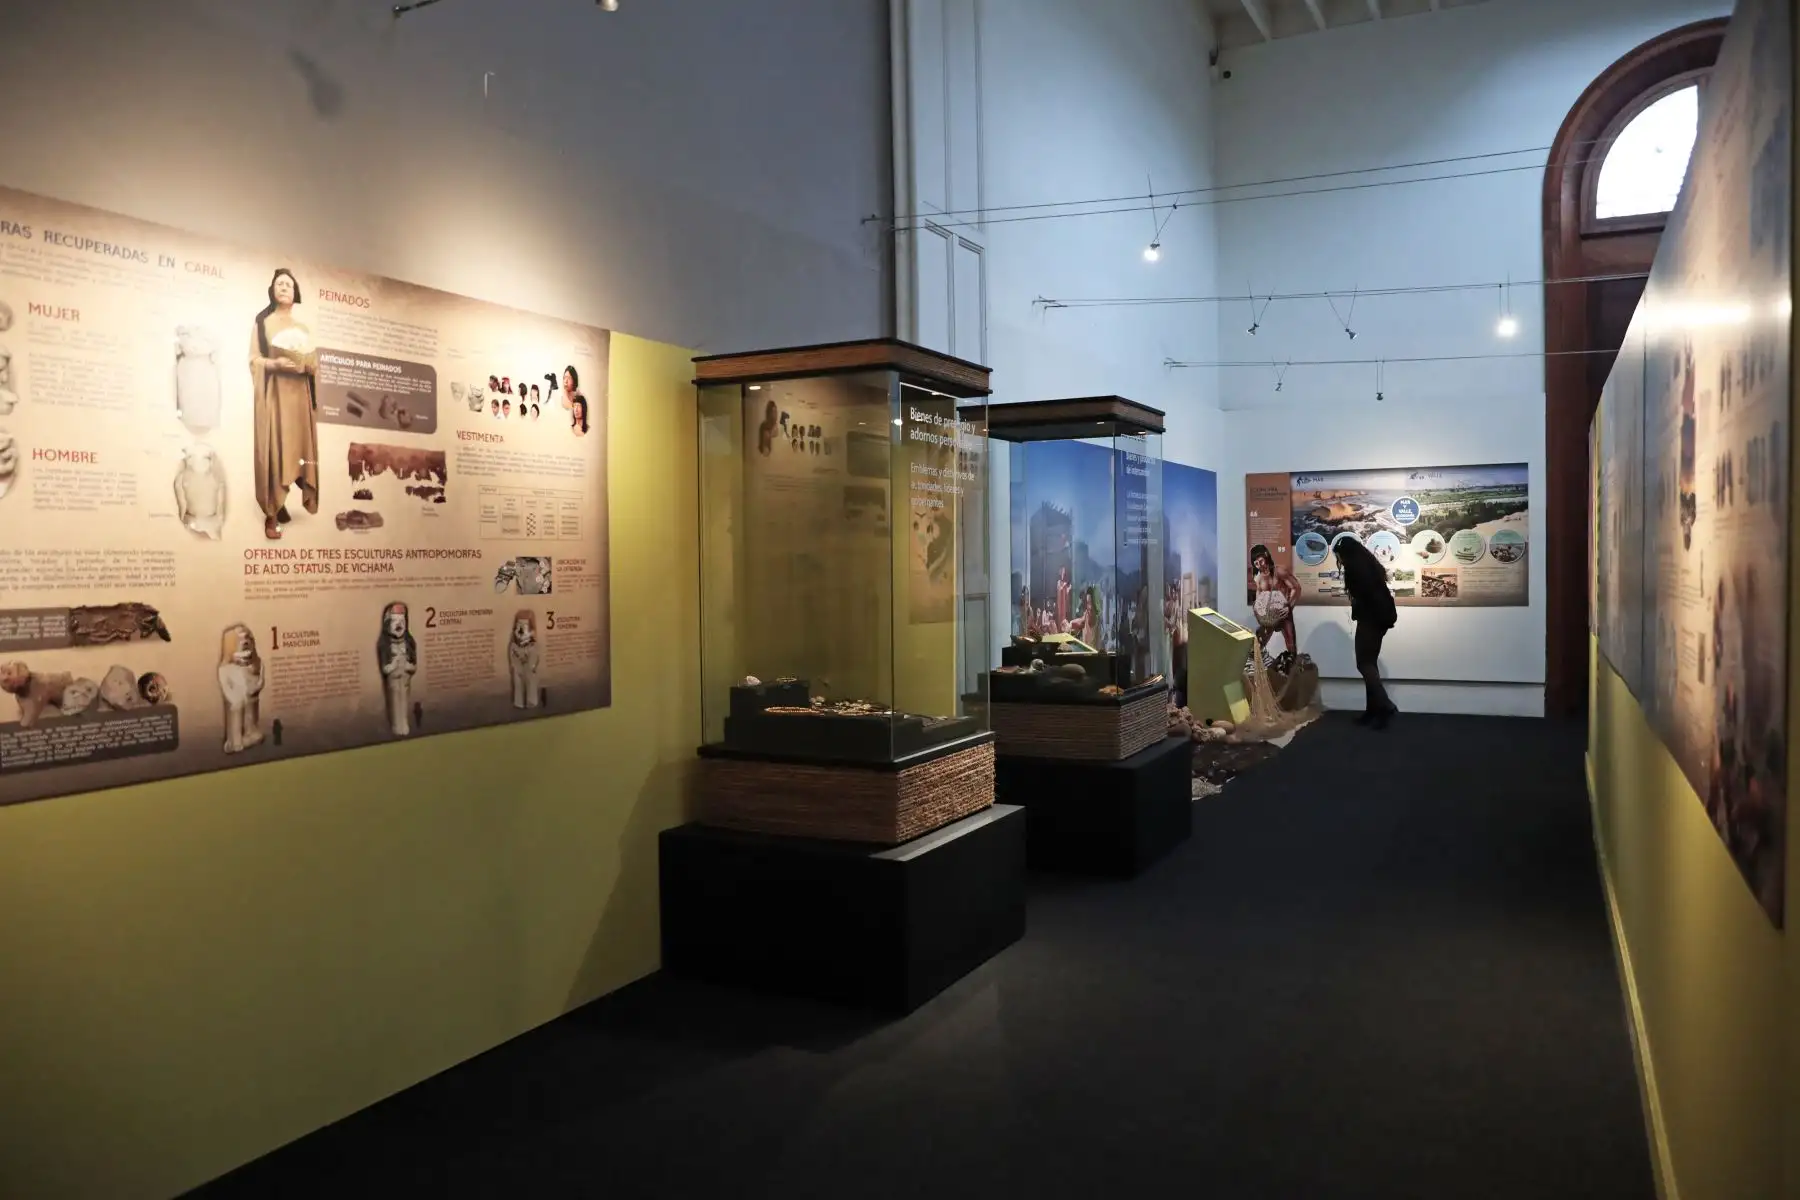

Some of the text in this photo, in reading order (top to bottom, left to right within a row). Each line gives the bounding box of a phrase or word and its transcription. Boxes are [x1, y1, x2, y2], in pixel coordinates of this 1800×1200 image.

[0, 220, 226, 280] RAS RECUPERADAS EN CARAL
[319, 288, 370, 308] PEINADOS
[28, 301, 80, 322] MUJER
[356, 360, 372, 369] PARA
[372, 362, 402, 374] PEINADOS
[910, 407, 933, 424] Bienes
[934, 411, 943, 426] de
[972, 422, 976, 435] y
[456, 430, 505, 443] VESTIMENTA
[910, 427, 938, 444] adornos
[32, 448, 99, 464] HOMBRE
[244, 548, 482, 560] OFRENDA DE TRES ESCULTURAS ANTROPOMORFAS
[244, 564, 260, 575] DE
[262, 563, 290, 575] ALTO
[336, 562, 349, 573] DE
[351, 562, 395, 573] VICHAMA
[425, 606, 437, 628] 2
[546, 610, 555, 630] 3
[271, 625, 279, 651] 1
[282, 630, 319, 640] ESCULTURA
[282, 639, 321, 648] MASCULINA
